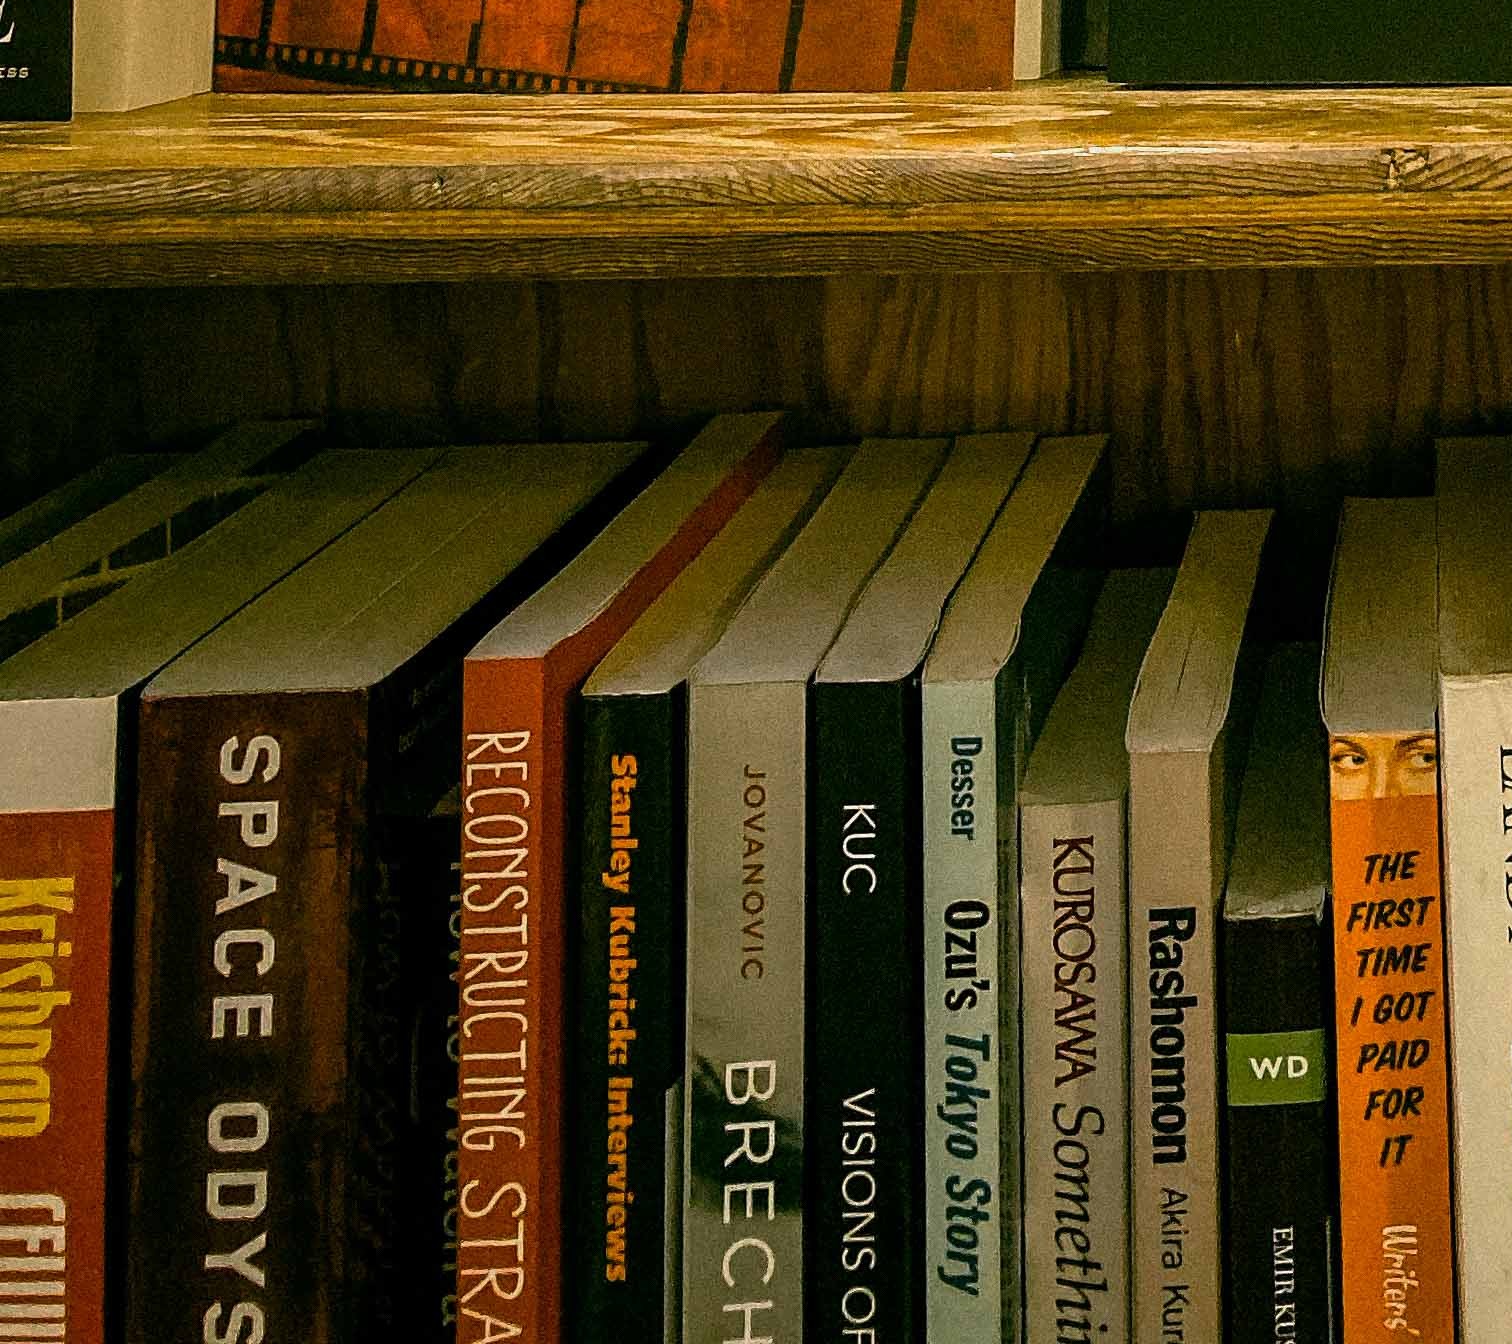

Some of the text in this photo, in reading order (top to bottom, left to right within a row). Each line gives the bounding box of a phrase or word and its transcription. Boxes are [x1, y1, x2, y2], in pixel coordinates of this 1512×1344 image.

[603, 753, 640, 894] Stanley
[1364, 851, 1421, 884] THE
[1346, 896, 1436, 933] FIRST
[1052, 835, 1098, 1089] KUROSAWA
[1356, 943, 1434, 978] TIME
[203, 734, 283, 1344] SPACE ODYS
[459, 730, 532, 1344] RECONSTRUCTING STRA
[937, 736, 992, 1298] Desser Ozu's Tokyo Story
[1148, 907, 1199, 1166] Rashomon
[1350, 991, 1435, 1027] I GOT
[721, 764, 778, 1344] JOVANOVIC BRECH
[842, 803, 877, 1344] KUC VISIONS OF
[1248, 1055, 1309, 1080] WD
[1356, 1039, 1431, 1074] PAID
[1364, 1085, 1425, 1121] FOR
[605, 1076, 636, 1283] Interviews
[1379, 1134, 1413, 1168] IT
[1161, 1187, 1189, 1270] Akira
[1272, 1224, 1295, 1292] EMIR
